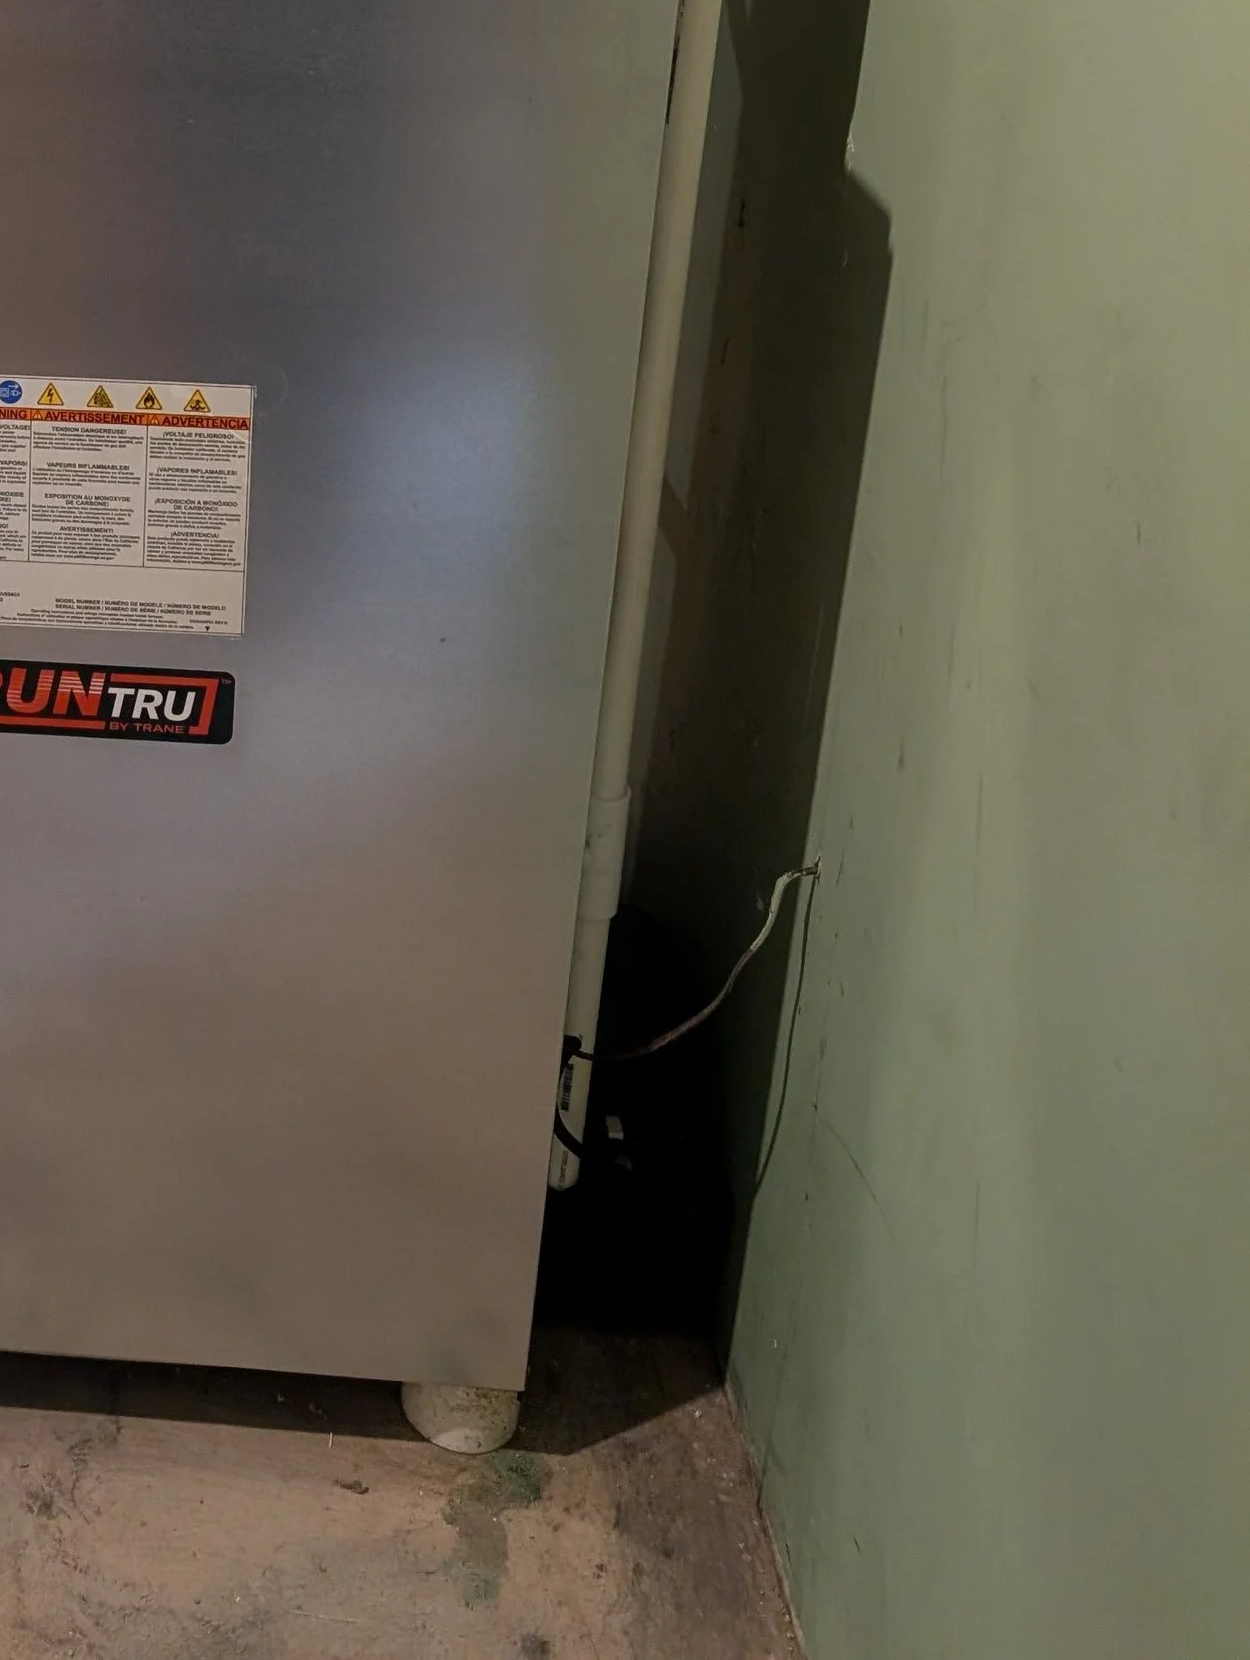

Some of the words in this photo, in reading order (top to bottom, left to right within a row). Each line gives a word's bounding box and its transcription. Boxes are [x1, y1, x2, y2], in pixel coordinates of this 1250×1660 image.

[44, 410, 145, 424] AVERTISSEMENT
[162, 417, 248, 429] ADVERTENCIA
[109, 721, 129, 731] BY
[132, 722, 185, 734] TRANE
